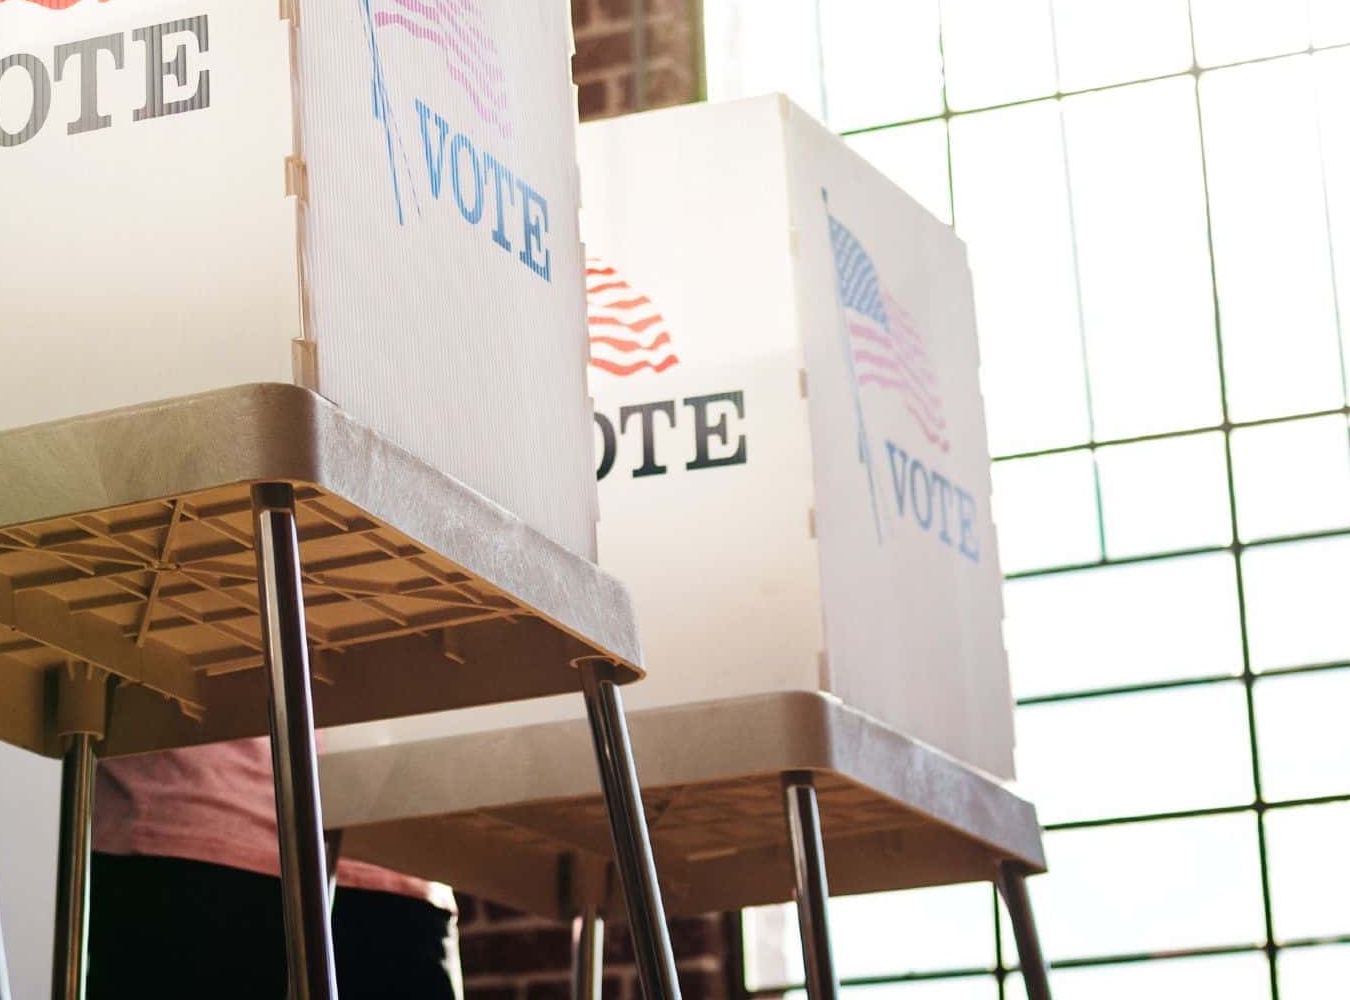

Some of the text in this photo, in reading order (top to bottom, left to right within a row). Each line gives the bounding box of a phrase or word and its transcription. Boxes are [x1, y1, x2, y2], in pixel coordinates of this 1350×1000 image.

[414, 95, 551, 283] VOTE
[594, 390, 747, 482] TE
[885, 437, 980, 564] VOTE
